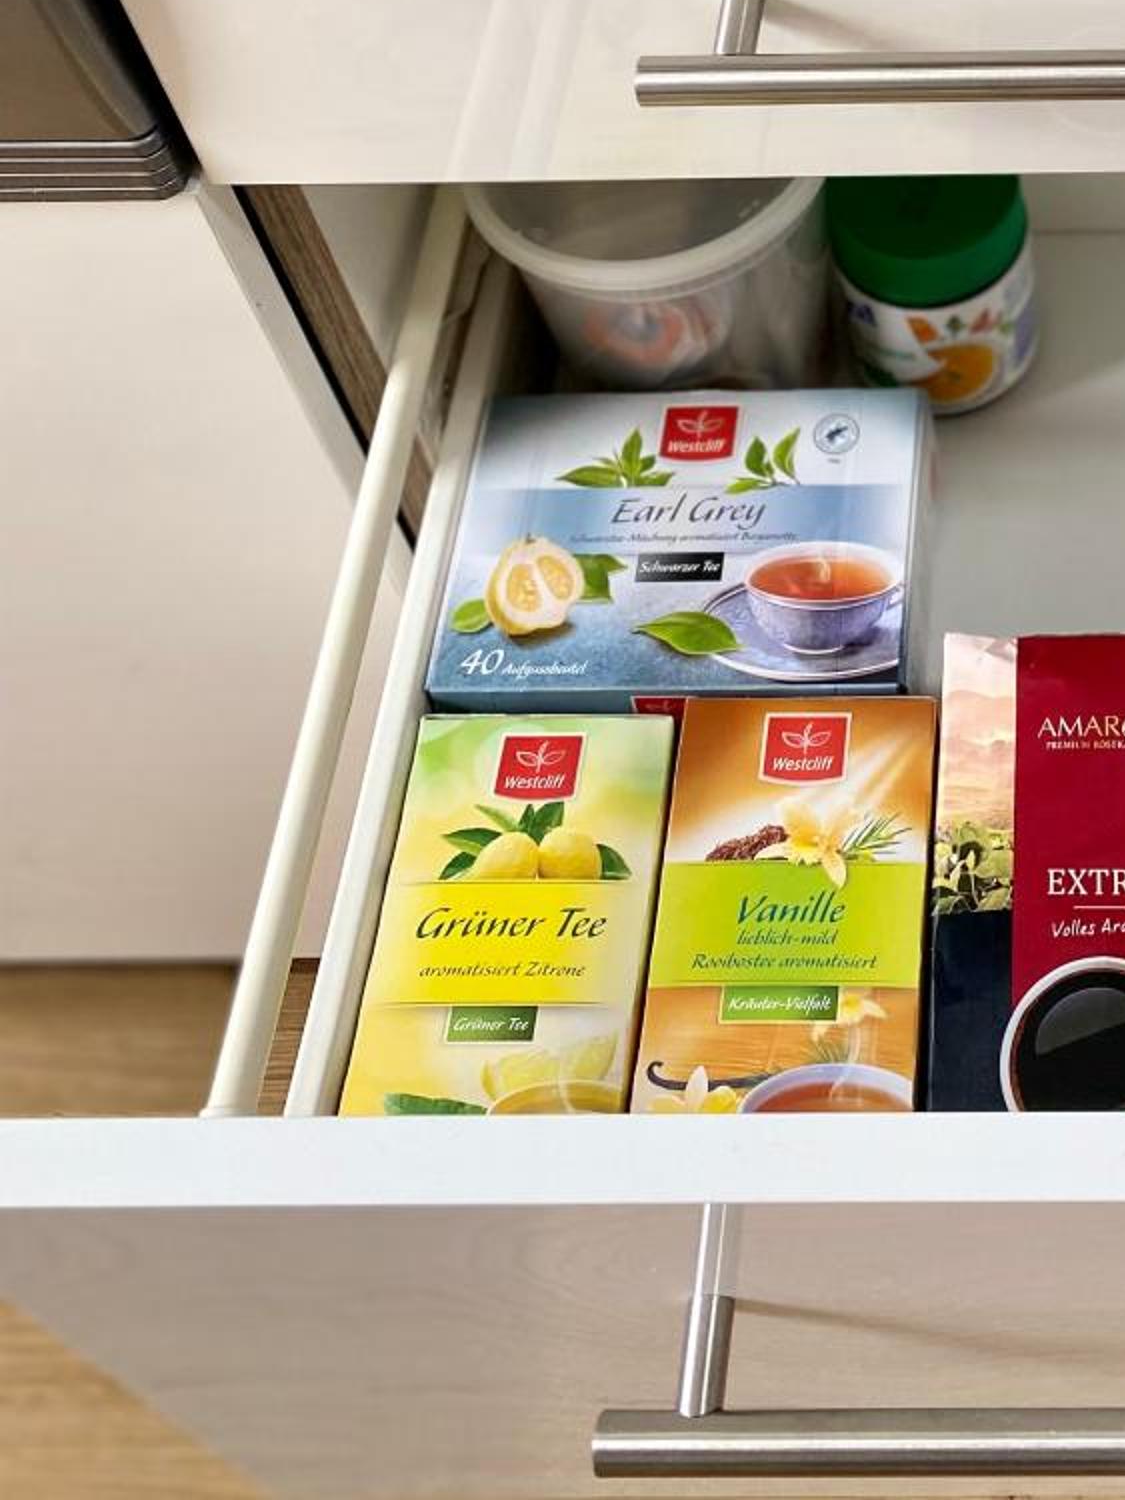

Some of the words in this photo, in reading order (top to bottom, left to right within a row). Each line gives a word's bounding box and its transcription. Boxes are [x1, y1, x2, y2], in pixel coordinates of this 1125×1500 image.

[611, 492, 687, 523] Earl
[688, 496, 767, 530] Grey
[639, 560, 700, 574] Schwarzer
[702, 560, 722, 573] Tee
[460, 649, 504, 676] 40
[772, 755, 834, 771] Westcliff
[504, 773, 566, 789] Westcliff
[737, 891, 846, 925] Vanille
[415, 907, 546, 939] Grüner
[556, 907, 609, 938] Tee
[1051, 918, 1096, 938] Volles
[737, 928, 839, 946] lieblich-mild
[419, 960, 521, 978] aromatisiert
[524, 961, 587, 977] Zitrone
[778, 954, 878, 970] aromatisiert
[453, 1016, 505, 1032] Grüner
[508, 1017, 530, 1031] Tee
